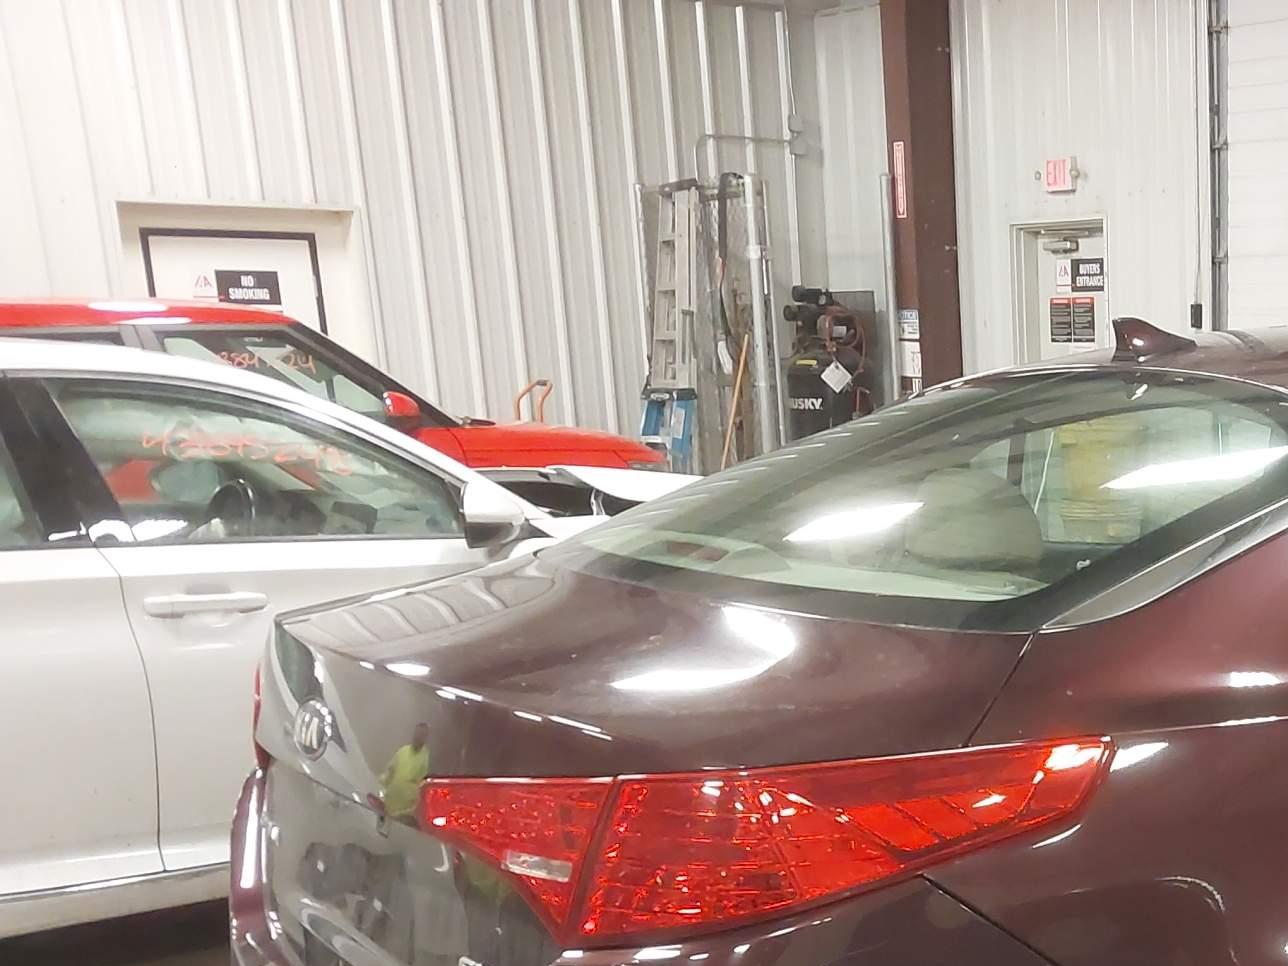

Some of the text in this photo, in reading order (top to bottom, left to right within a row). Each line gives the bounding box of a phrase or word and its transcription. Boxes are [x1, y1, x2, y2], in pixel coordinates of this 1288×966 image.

[1079, 263, 1101, 275] BUYERS
[240, 275, 254, 287] NO
[1076, 275, 1104, 288] ENTRANCE
[228, 287, 271, 300] SMOKING
